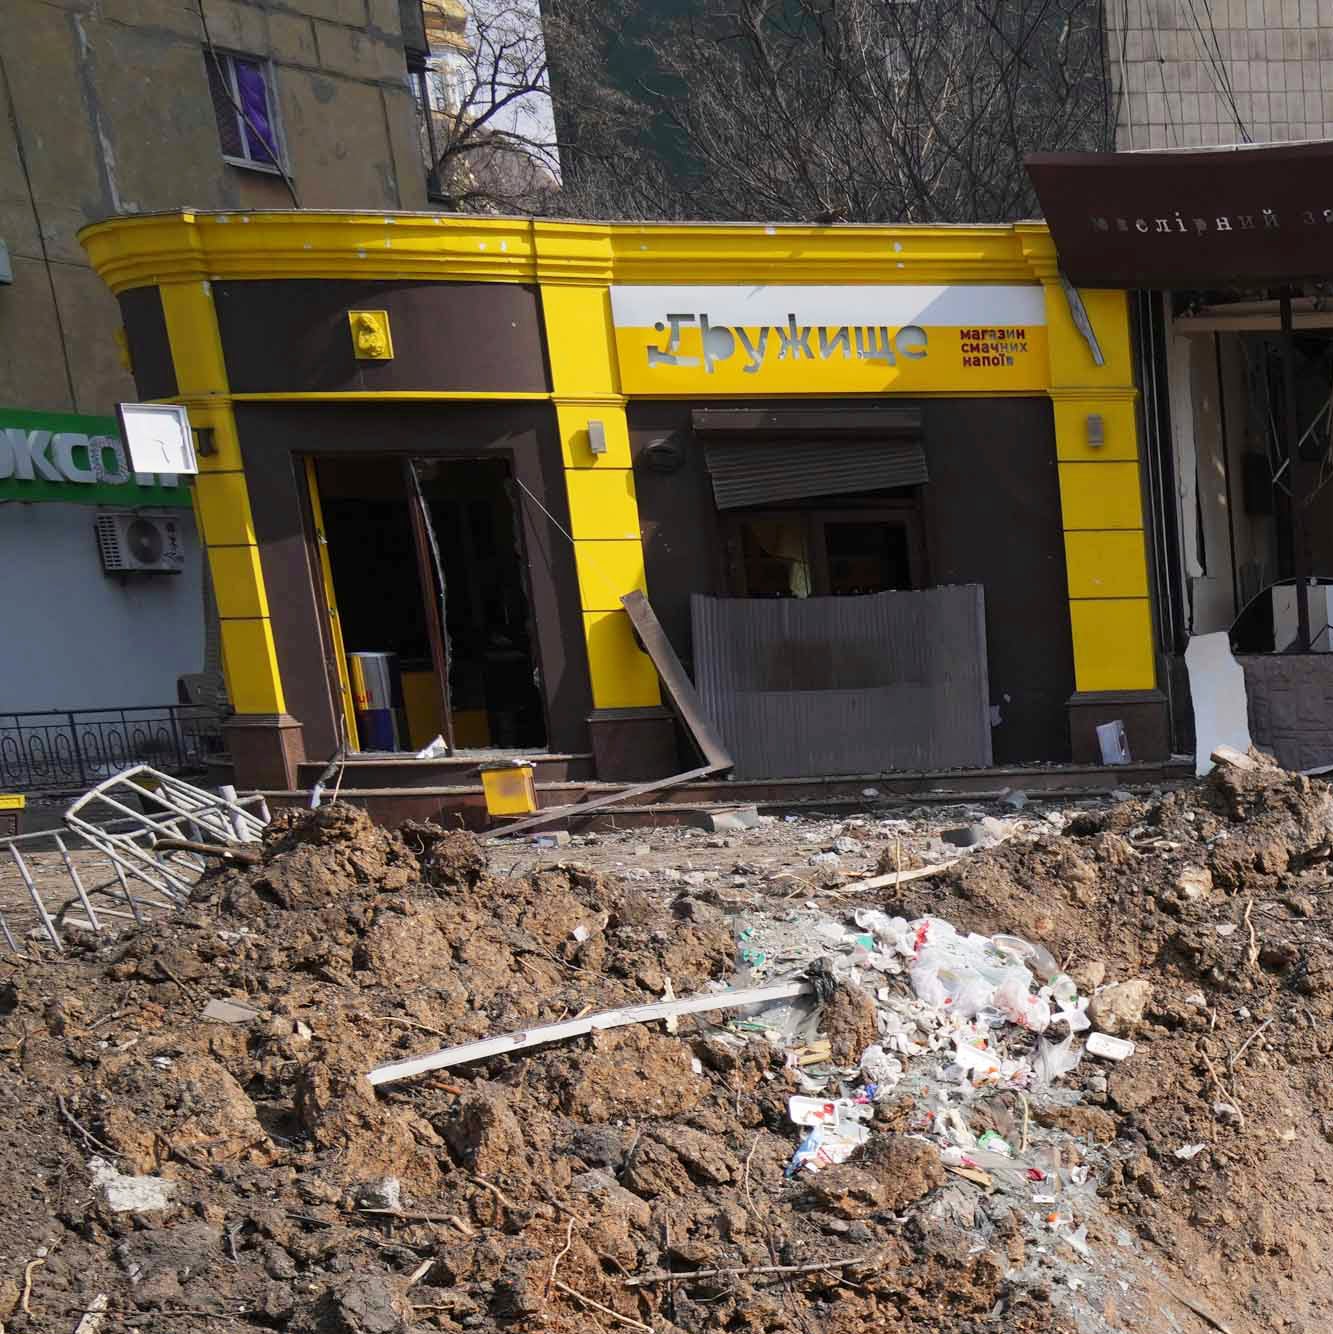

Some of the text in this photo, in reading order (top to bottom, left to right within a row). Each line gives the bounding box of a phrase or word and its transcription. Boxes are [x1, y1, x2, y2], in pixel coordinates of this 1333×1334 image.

[960, 329, 1025, 340] магазин
[646, 312, 929, 374] Дружище
[961, 343, 1028, 353] смачних
